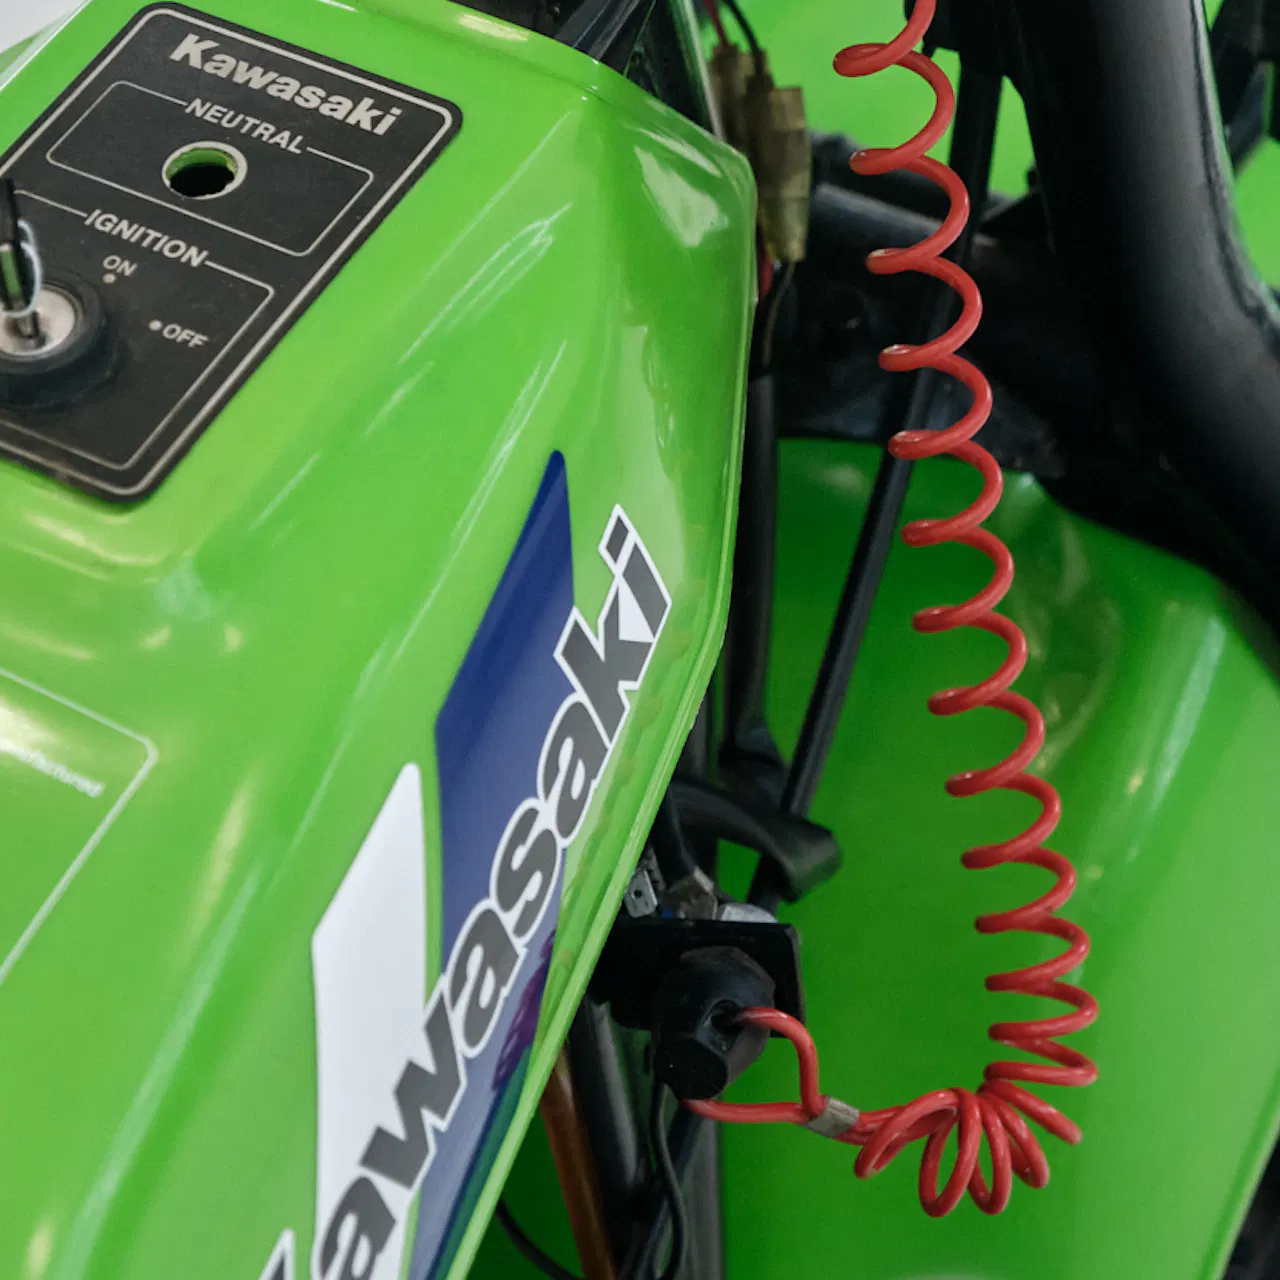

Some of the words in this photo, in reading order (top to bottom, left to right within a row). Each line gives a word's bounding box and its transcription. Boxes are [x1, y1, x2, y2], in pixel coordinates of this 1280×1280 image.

[169, 33, 402, 137] Kawasaki
[185, 98, 306, 154] NEUTRAL
[84, 209, 209, 268] IGNITION
[102, 255, 138, 277] ON
[162, 323, 209, 350] OFF
[258, 504, 672, 1280] awasaki
